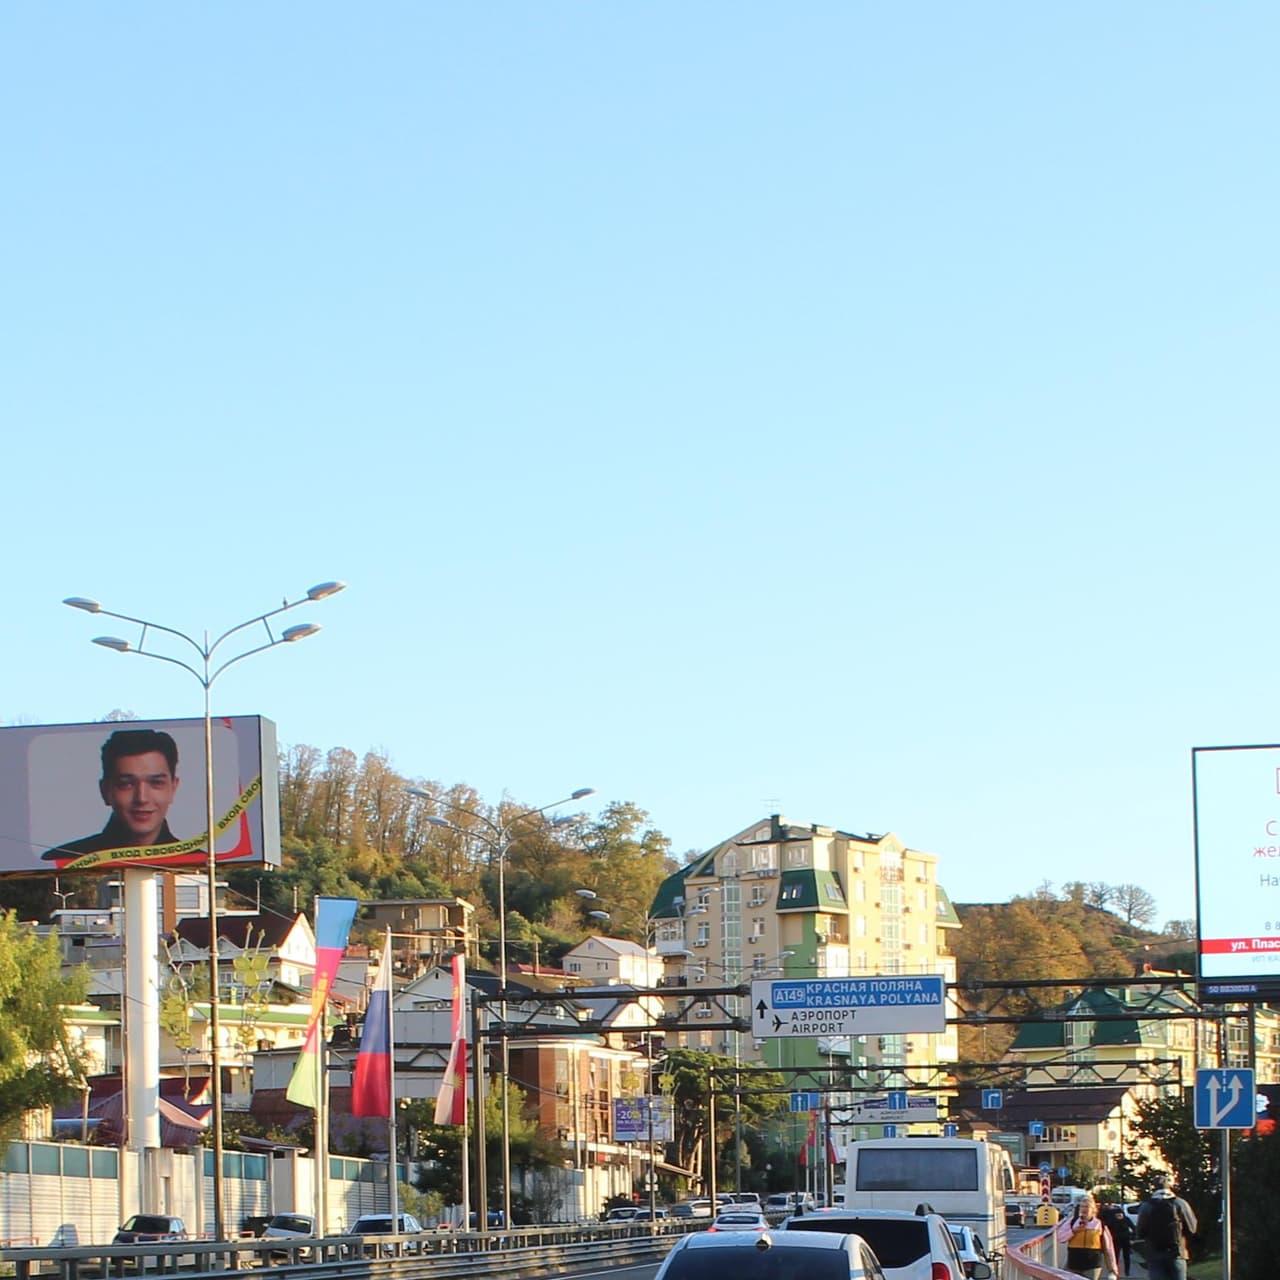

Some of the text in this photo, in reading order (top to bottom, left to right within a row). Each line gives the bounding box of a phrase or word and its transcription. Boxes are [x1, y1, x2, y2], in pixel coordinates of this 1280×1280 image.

[217, 804, 242, 829] ВХОД
[1265, 820, 1278, 836] С
[111, 849, 141, 859] ВХОД
[1264, 921, 1271, 931] 8
[1231, 939, 1249, 952] ул.
[806, 980, 923, 994] КРАСНАЯ ПОЛЯНА
[775, 989, 804, 1002] A149
[806, 992, 940, 1007] KRASNAYA POLYANA
[791, 1009, 857, 1021] АЭРОПОРТ
[791, 1022, 844, 1034] AIRPORT
